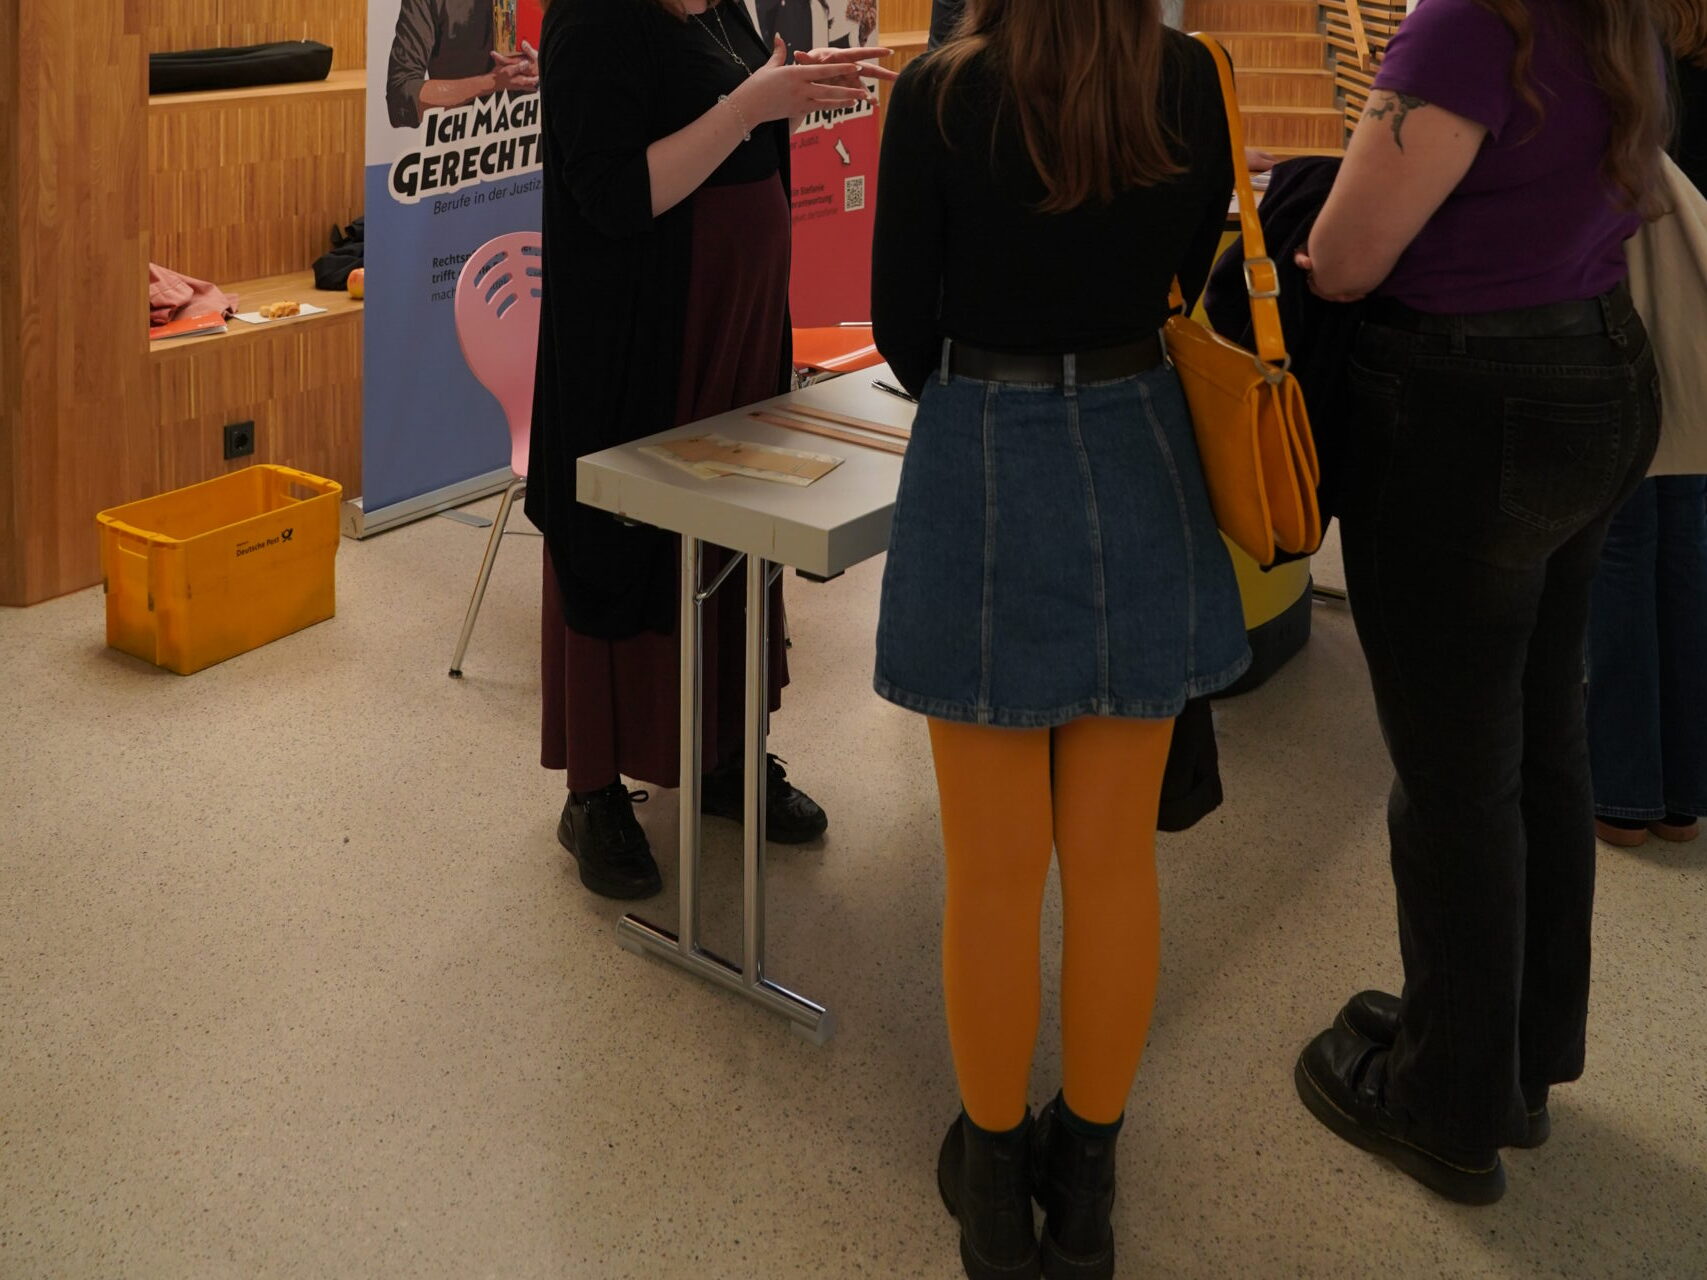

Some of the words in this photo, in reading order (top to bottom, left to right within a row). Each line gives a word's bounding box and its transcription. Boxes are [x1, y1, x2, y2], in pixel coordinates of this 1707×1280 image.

[425, 111, 468, 147] ICH
[393, 132, 544, 196] GERECHTI
[434, 196, 472, 216] Berufe
[474, 191, 486, 205] in
[488, 187, 508, 202] der
[432, 250, 472, 268] Rechts
[431, 269, 456, 284] trifft
[236, 541, 265, 557] Deutsche
[266, 536, 280, 547] Post
